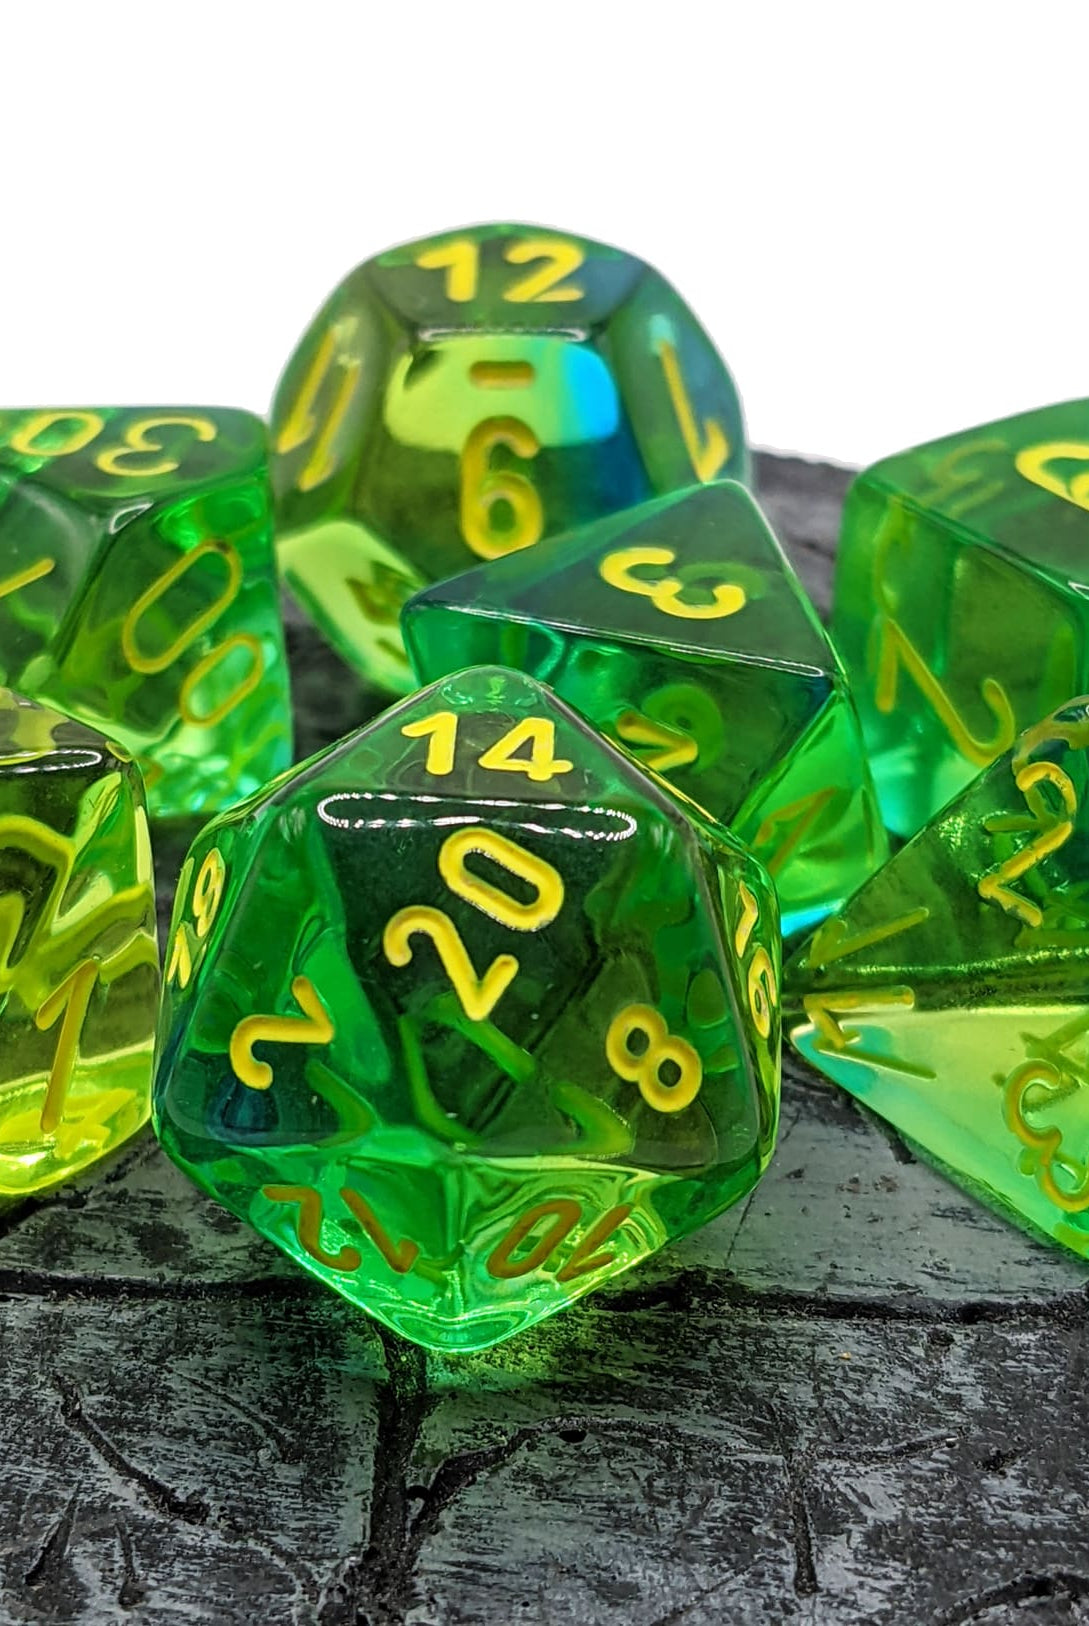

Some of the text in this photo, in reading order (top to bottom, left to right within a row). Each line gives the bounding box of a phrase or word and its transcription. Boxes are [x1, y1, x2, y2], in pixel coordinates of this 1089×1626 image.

[417, 239, 585, 302] 12
[11, 411, 217, 477] 30
[600, 546, 747, 620] 3
[121, 538, 265, 729] 00
[401, 711, 573, 782] 14
[383, 827, 566, 1021] 20
[735, 879, 778, 1039] 16
[230, 976, 335, 1090] 2
[605, 1003, 703, 1114] 8
[262, 1184, 421, 1275] 12
[486, 1199, 633, 1282] 10
